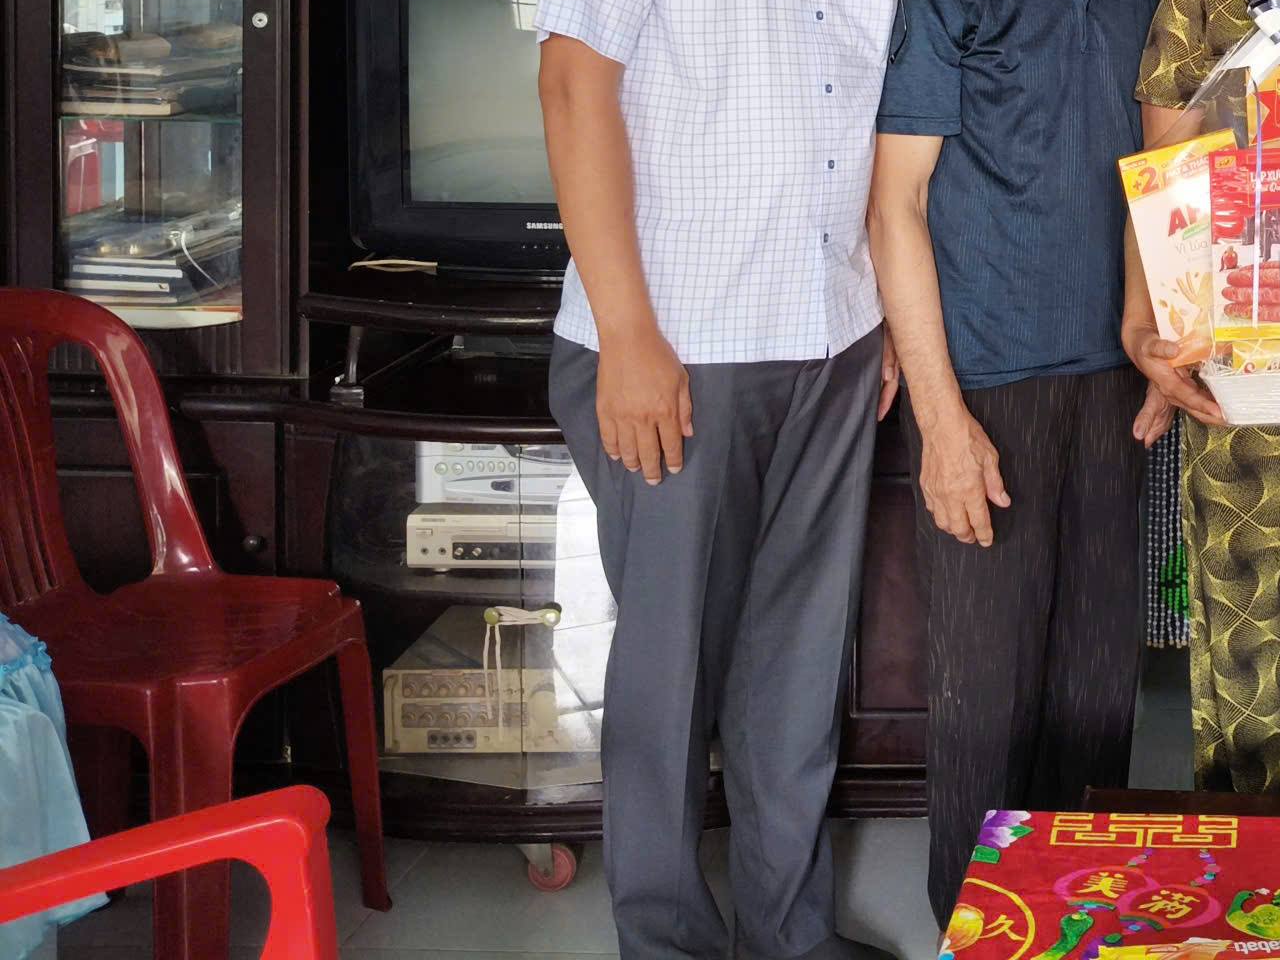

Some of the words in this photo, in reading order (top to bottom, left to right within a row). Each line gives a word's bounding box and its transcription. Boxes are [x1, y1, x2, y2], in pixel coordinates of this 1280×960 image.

[1250, 170, 1266, 182] LP
[526, 222, 564, 230] SAMSUNG
[1076, 871, 1129, 899] 美
